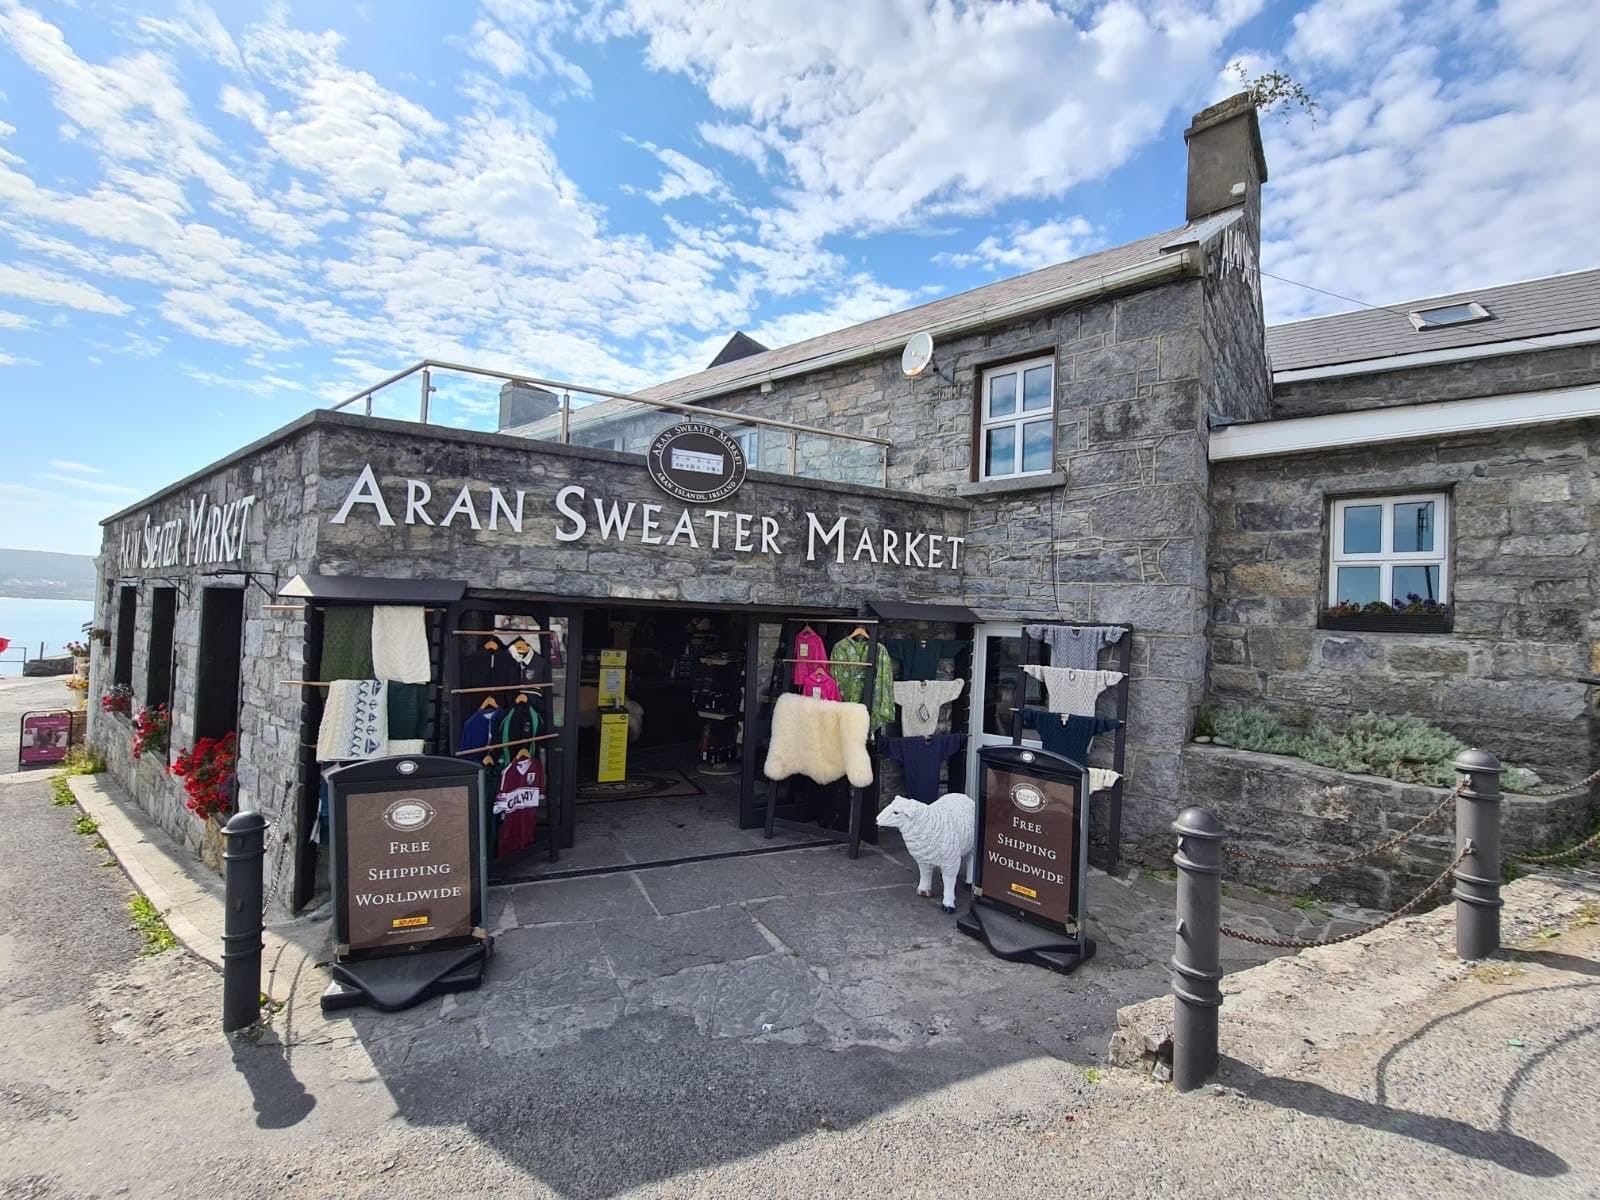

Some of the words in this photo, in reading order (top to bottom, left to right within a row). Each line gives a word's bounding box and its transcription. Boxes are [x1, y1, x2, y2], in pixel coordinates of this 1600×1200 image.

[652, 431, 673, 457] ARAN
[674, 424, 715, 436] SWEATER
[717, 431, 743, 465] MARKET
[656, 472, 674, 489] ARAN
[708, 481, 736, 499] IRELAND
[330, 463, 526, 533] ARAN
[555, 485, 782, 554] SWEATER
[805, 512, 966, 570] MARKET
[186, 494, 256, 567] MARKET
[1012, 816, 1042, 834] FREE
[389, 841, 430, 854] FREE
[997, 833, 1057, 860] SHIPPING
[368, 864, 450, 881] SHIPPING
[988, 851, 1064, 885] WORLDWIDE
[355, 886, 462, 907] WORLDWIDE
